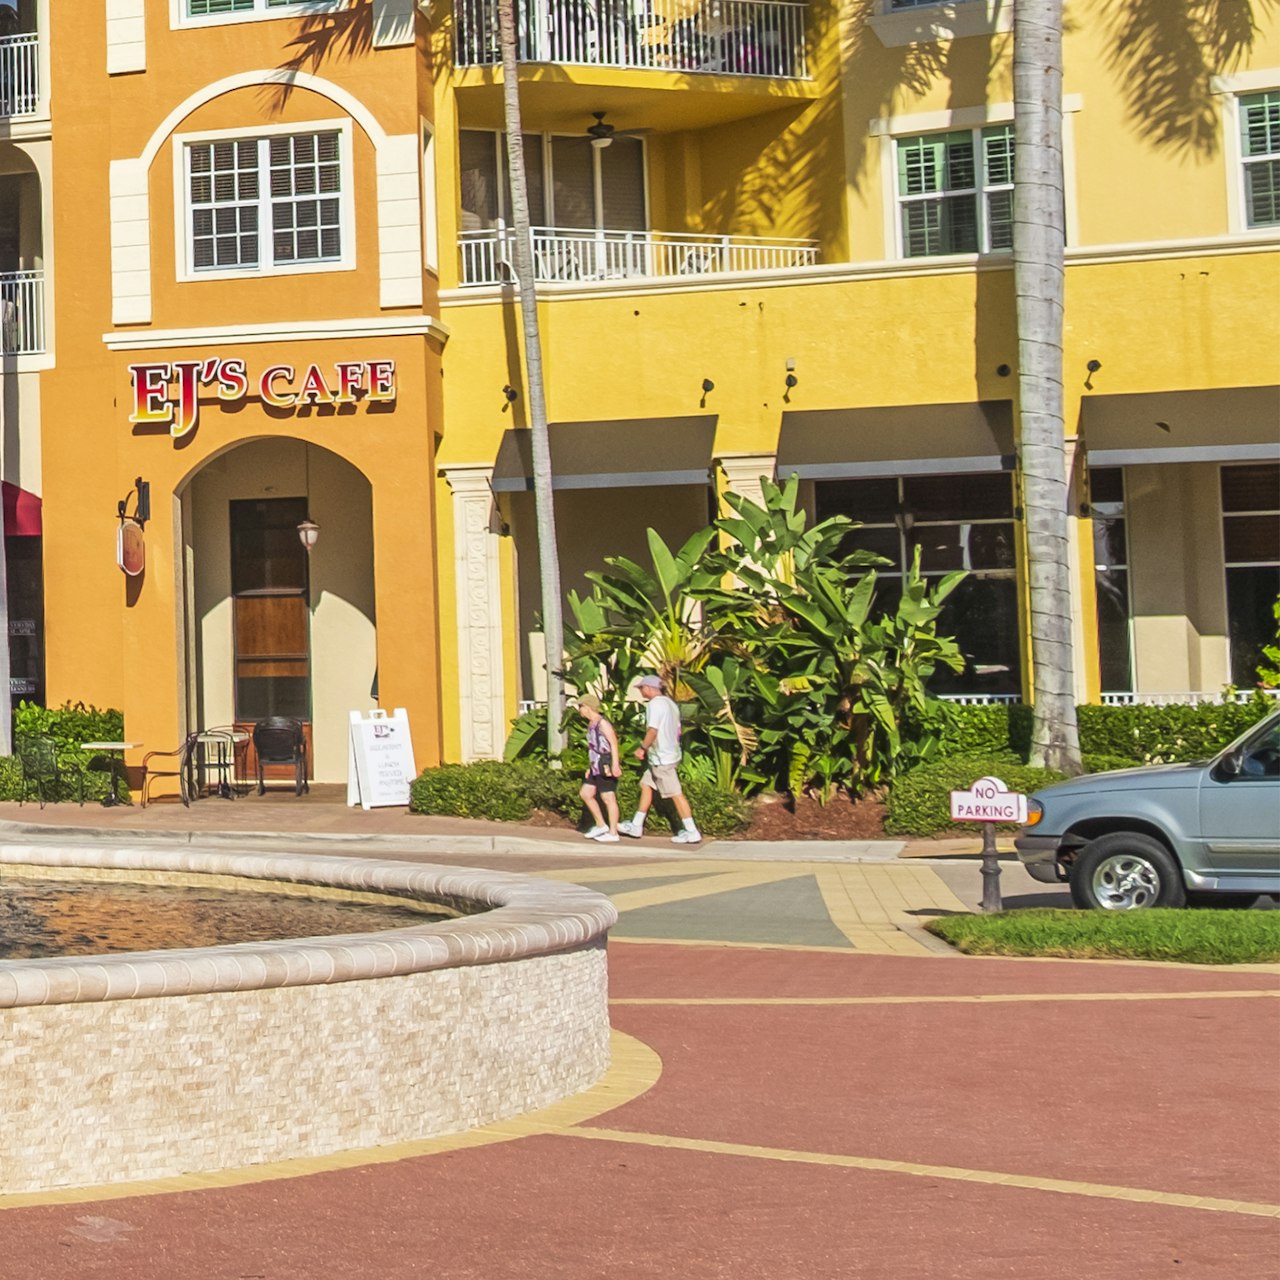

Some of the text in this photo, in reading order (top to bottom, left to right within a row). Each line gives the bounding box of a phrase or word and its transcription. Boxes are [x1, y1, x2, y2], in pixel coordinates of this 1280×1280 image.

[128, 357, 397, 438] EJ'S CAFE
[975, 787, 995, 799] NO
[957, 804, 1014, 818] PARKING
